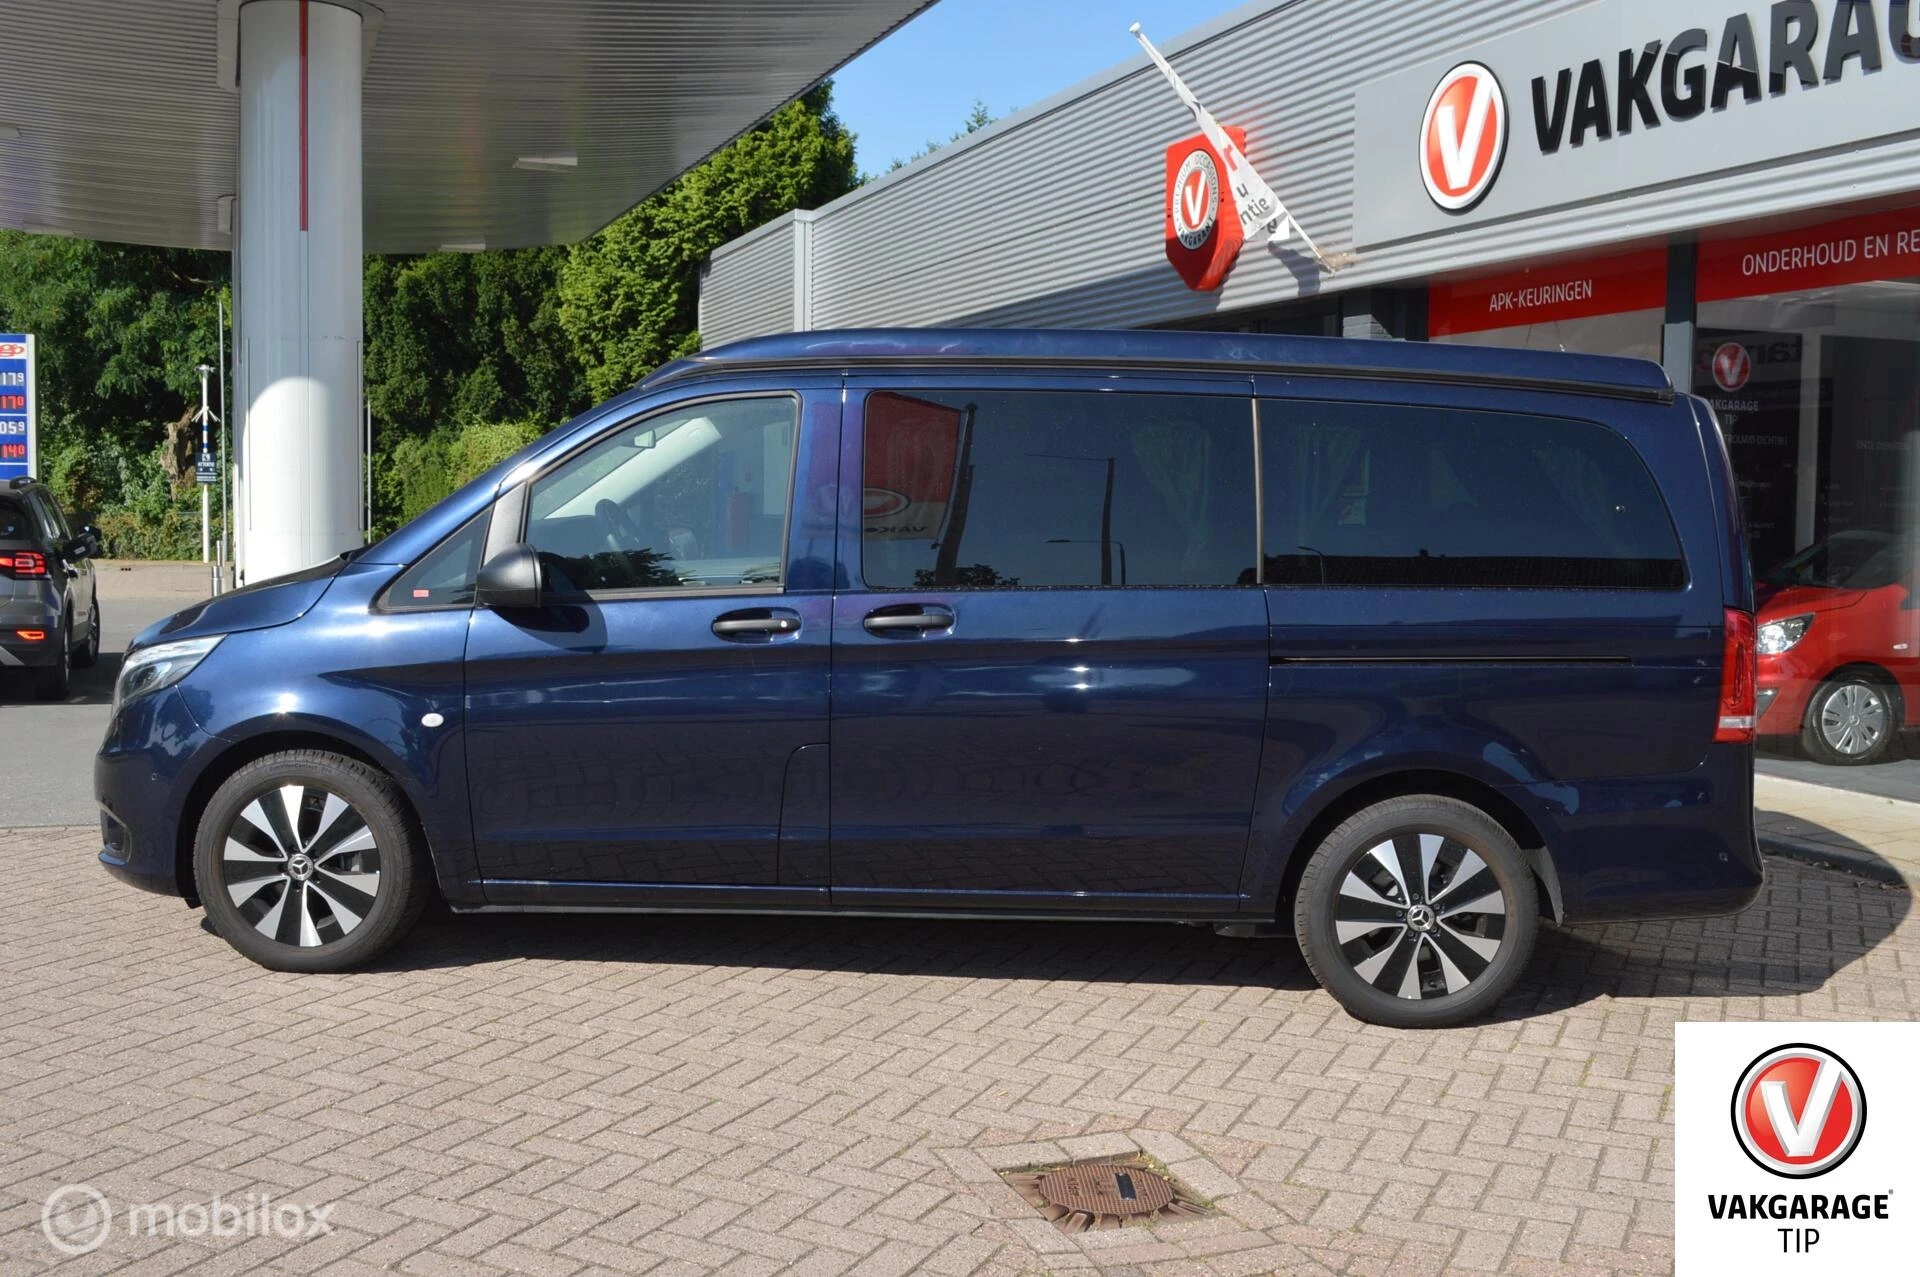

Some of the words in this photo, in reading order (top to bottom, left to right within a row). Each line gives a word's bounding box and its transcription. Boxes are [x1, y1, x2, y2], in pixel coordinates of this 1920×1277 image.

[1742, 239, 1856, 276] ONDERHOUD
[1864, 233, 1889, 259] EN
[1897, 229, 1920, 255] RE
[1489, 279, 1592, 312] APK-KEURINGEN
